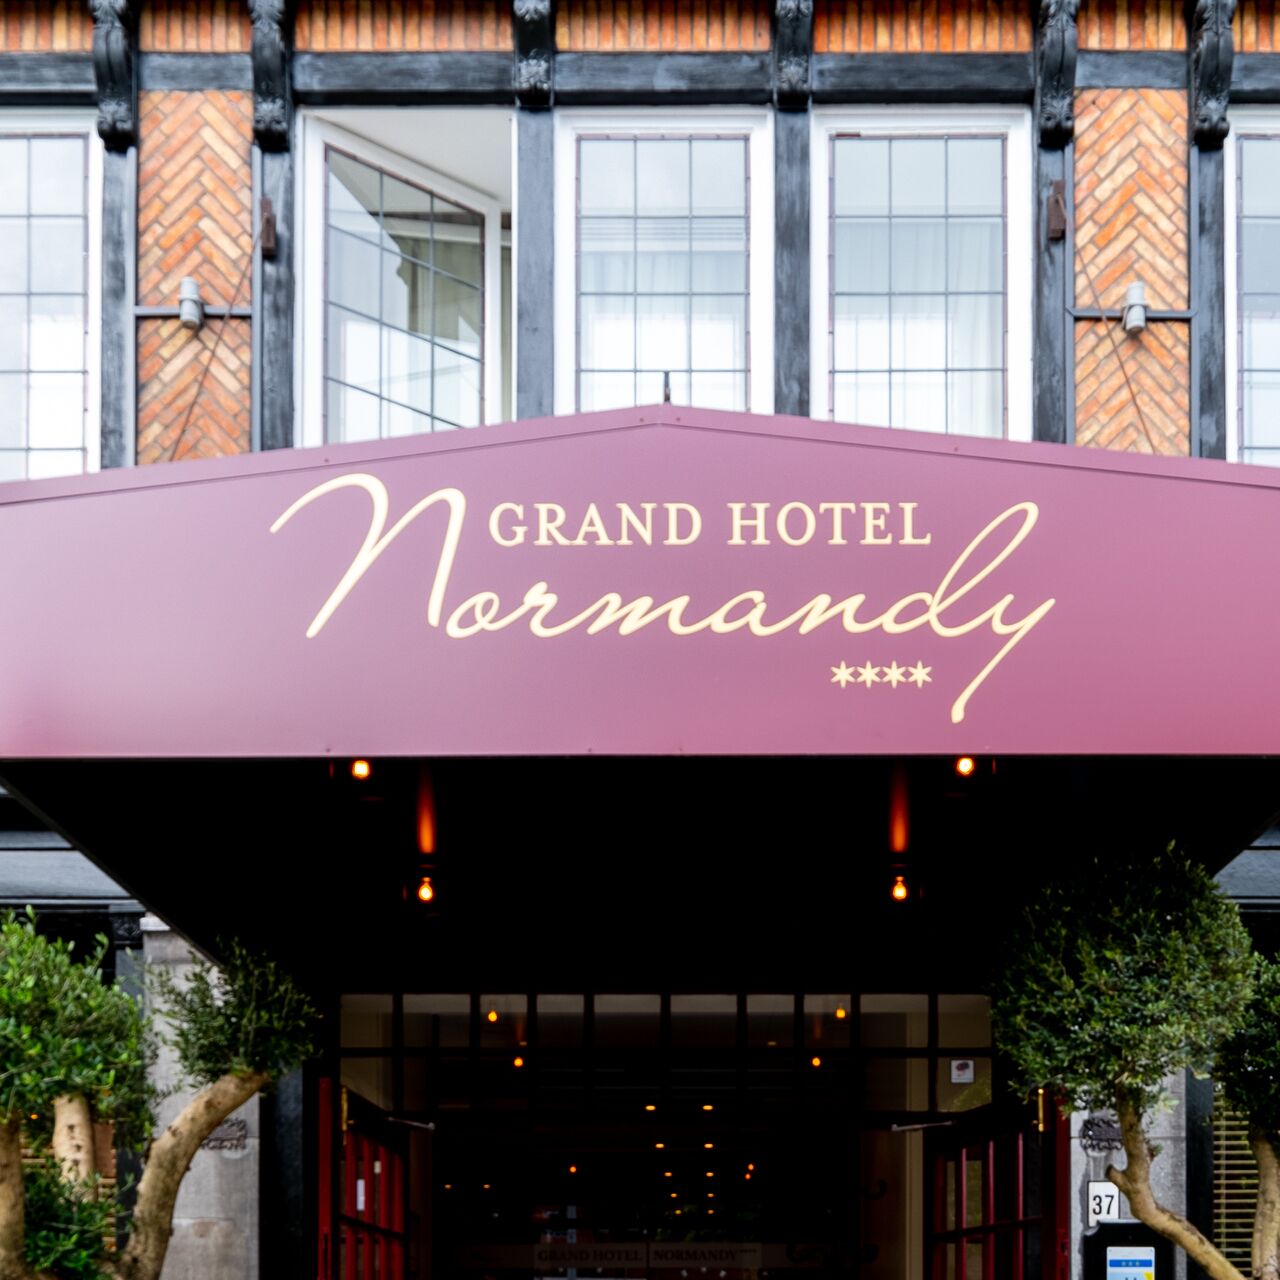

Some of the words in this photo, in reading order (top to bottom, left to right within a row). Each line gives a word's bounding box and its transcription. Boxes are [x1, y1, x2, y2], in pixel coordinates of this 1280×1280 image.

[488, 502, 702, 546] GRAND
[727, 501, 932, 546] HOTEL
[269, 472, 1056, 723] Normandy
[1092, 1194, 1115, 1215] 37
[537, 1249, 590, 1262] GRAND
[593, 1249, 644, 1262] HOTEL
[653, 1249, 738, 1262] NORMANDY
